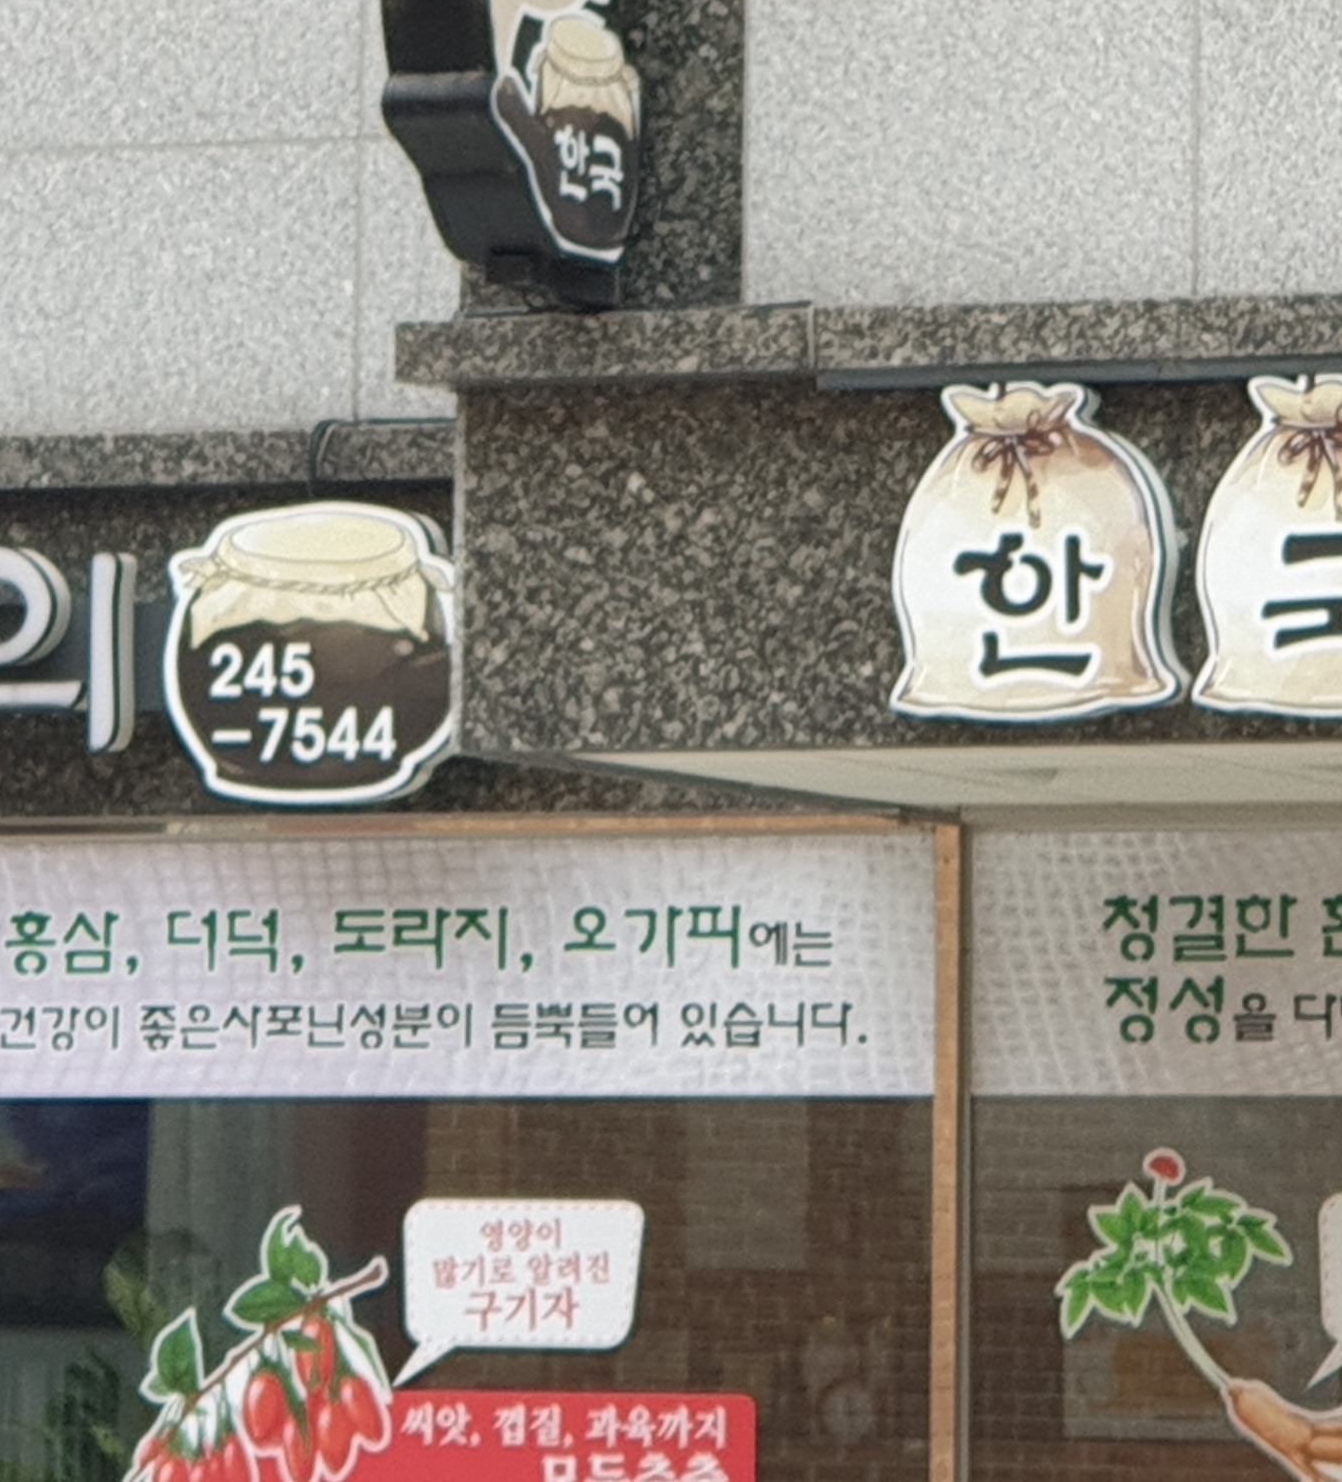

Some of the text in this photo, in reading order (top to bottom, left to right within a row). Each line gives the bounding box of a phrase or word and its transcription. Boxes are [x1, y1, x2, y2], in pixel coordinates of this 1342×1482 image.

[554, 124, 624, 212] 한국
[209, 642, 315, 698] 245
[211, 706, 397, 763] -7544
[4, 905, 834, 976] 홍삼, 더덕, 도라지, 오가피에는
[1102, 894, 1298, 963] 청결한
[0, 1005, 120, 1051] 건강이
[680, 1001, 868, 1050] 있습니다.
[1103, 975, 1277, 1044] 정성을
[480, 1217, 562, 1252] 영양이
[527, 1251, 611, 1286] 알려진
[464, 1286, 580, 1332] 구기자
[585, 1404, 728, 1450] 과육까지
